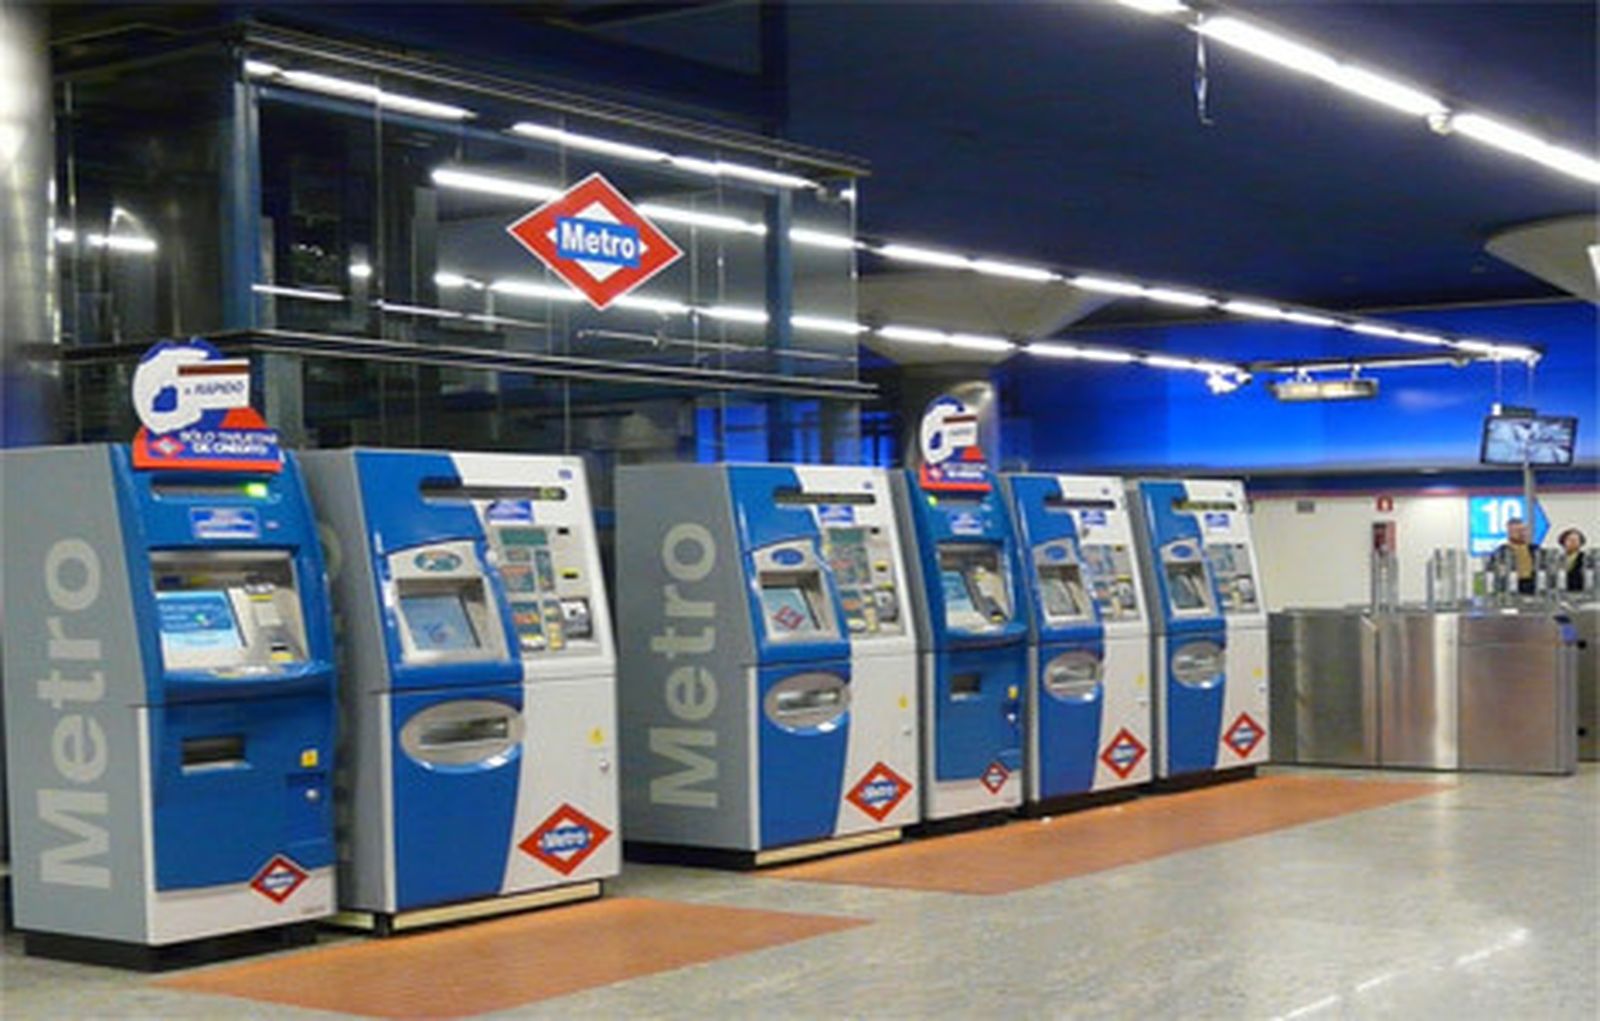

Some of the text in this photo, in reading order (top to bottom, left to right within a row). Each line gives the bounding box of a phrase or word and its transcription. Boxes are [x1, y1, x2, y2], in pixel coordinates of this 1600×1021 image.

[560, 221, 636, 260] Metro
[36, 538, 112, 889] Metro
[650, 521, 719, 809] Metro
